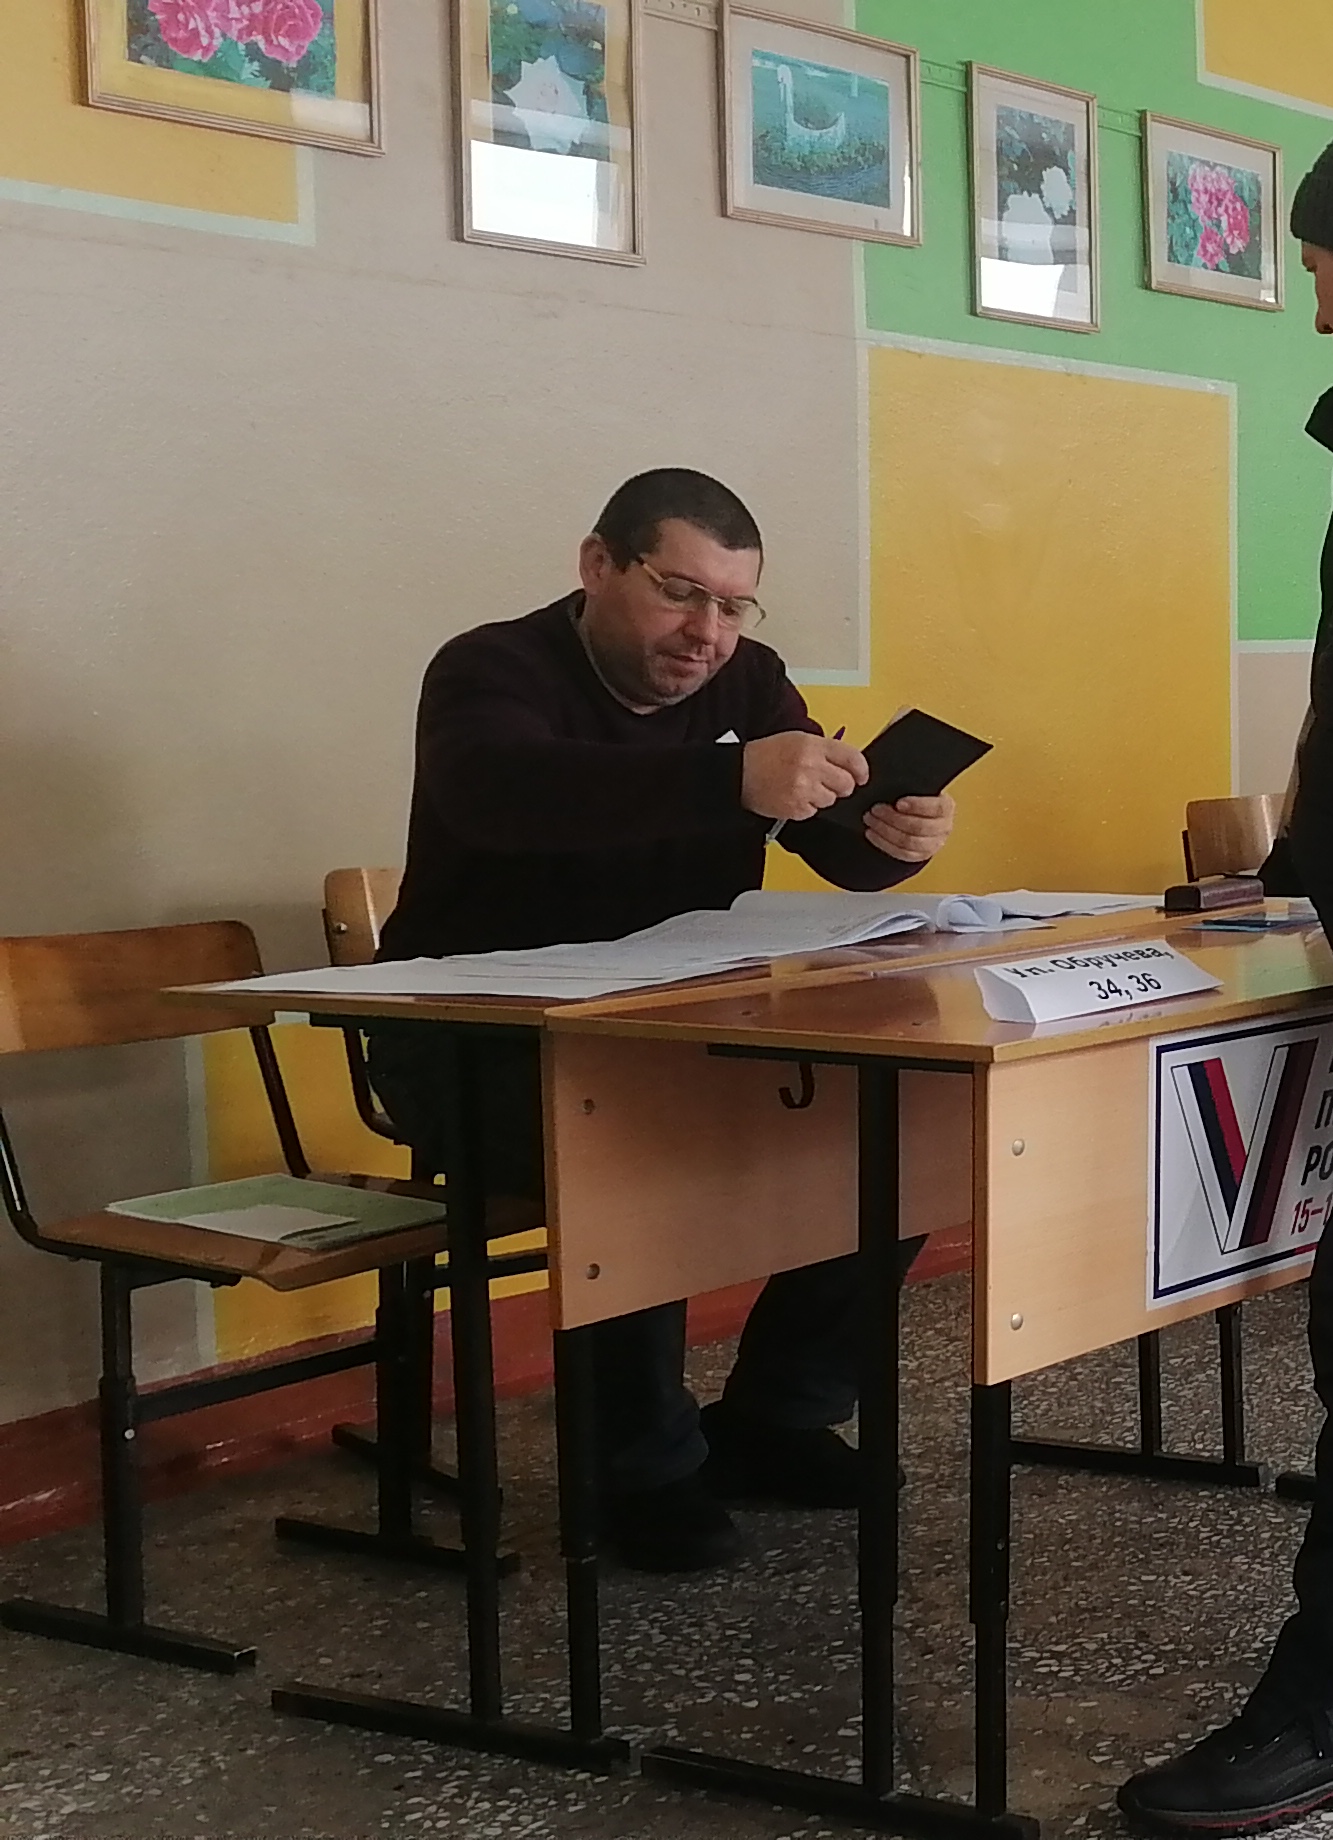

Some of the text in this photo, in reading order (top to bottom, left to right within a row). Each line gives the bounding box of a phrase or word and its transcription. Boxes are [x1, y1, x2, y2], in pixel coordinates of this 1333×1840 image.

[1003, 946, 1175, 978] Ул. Обручева,
[1089, 972, 1162, 1000] 34, 36
